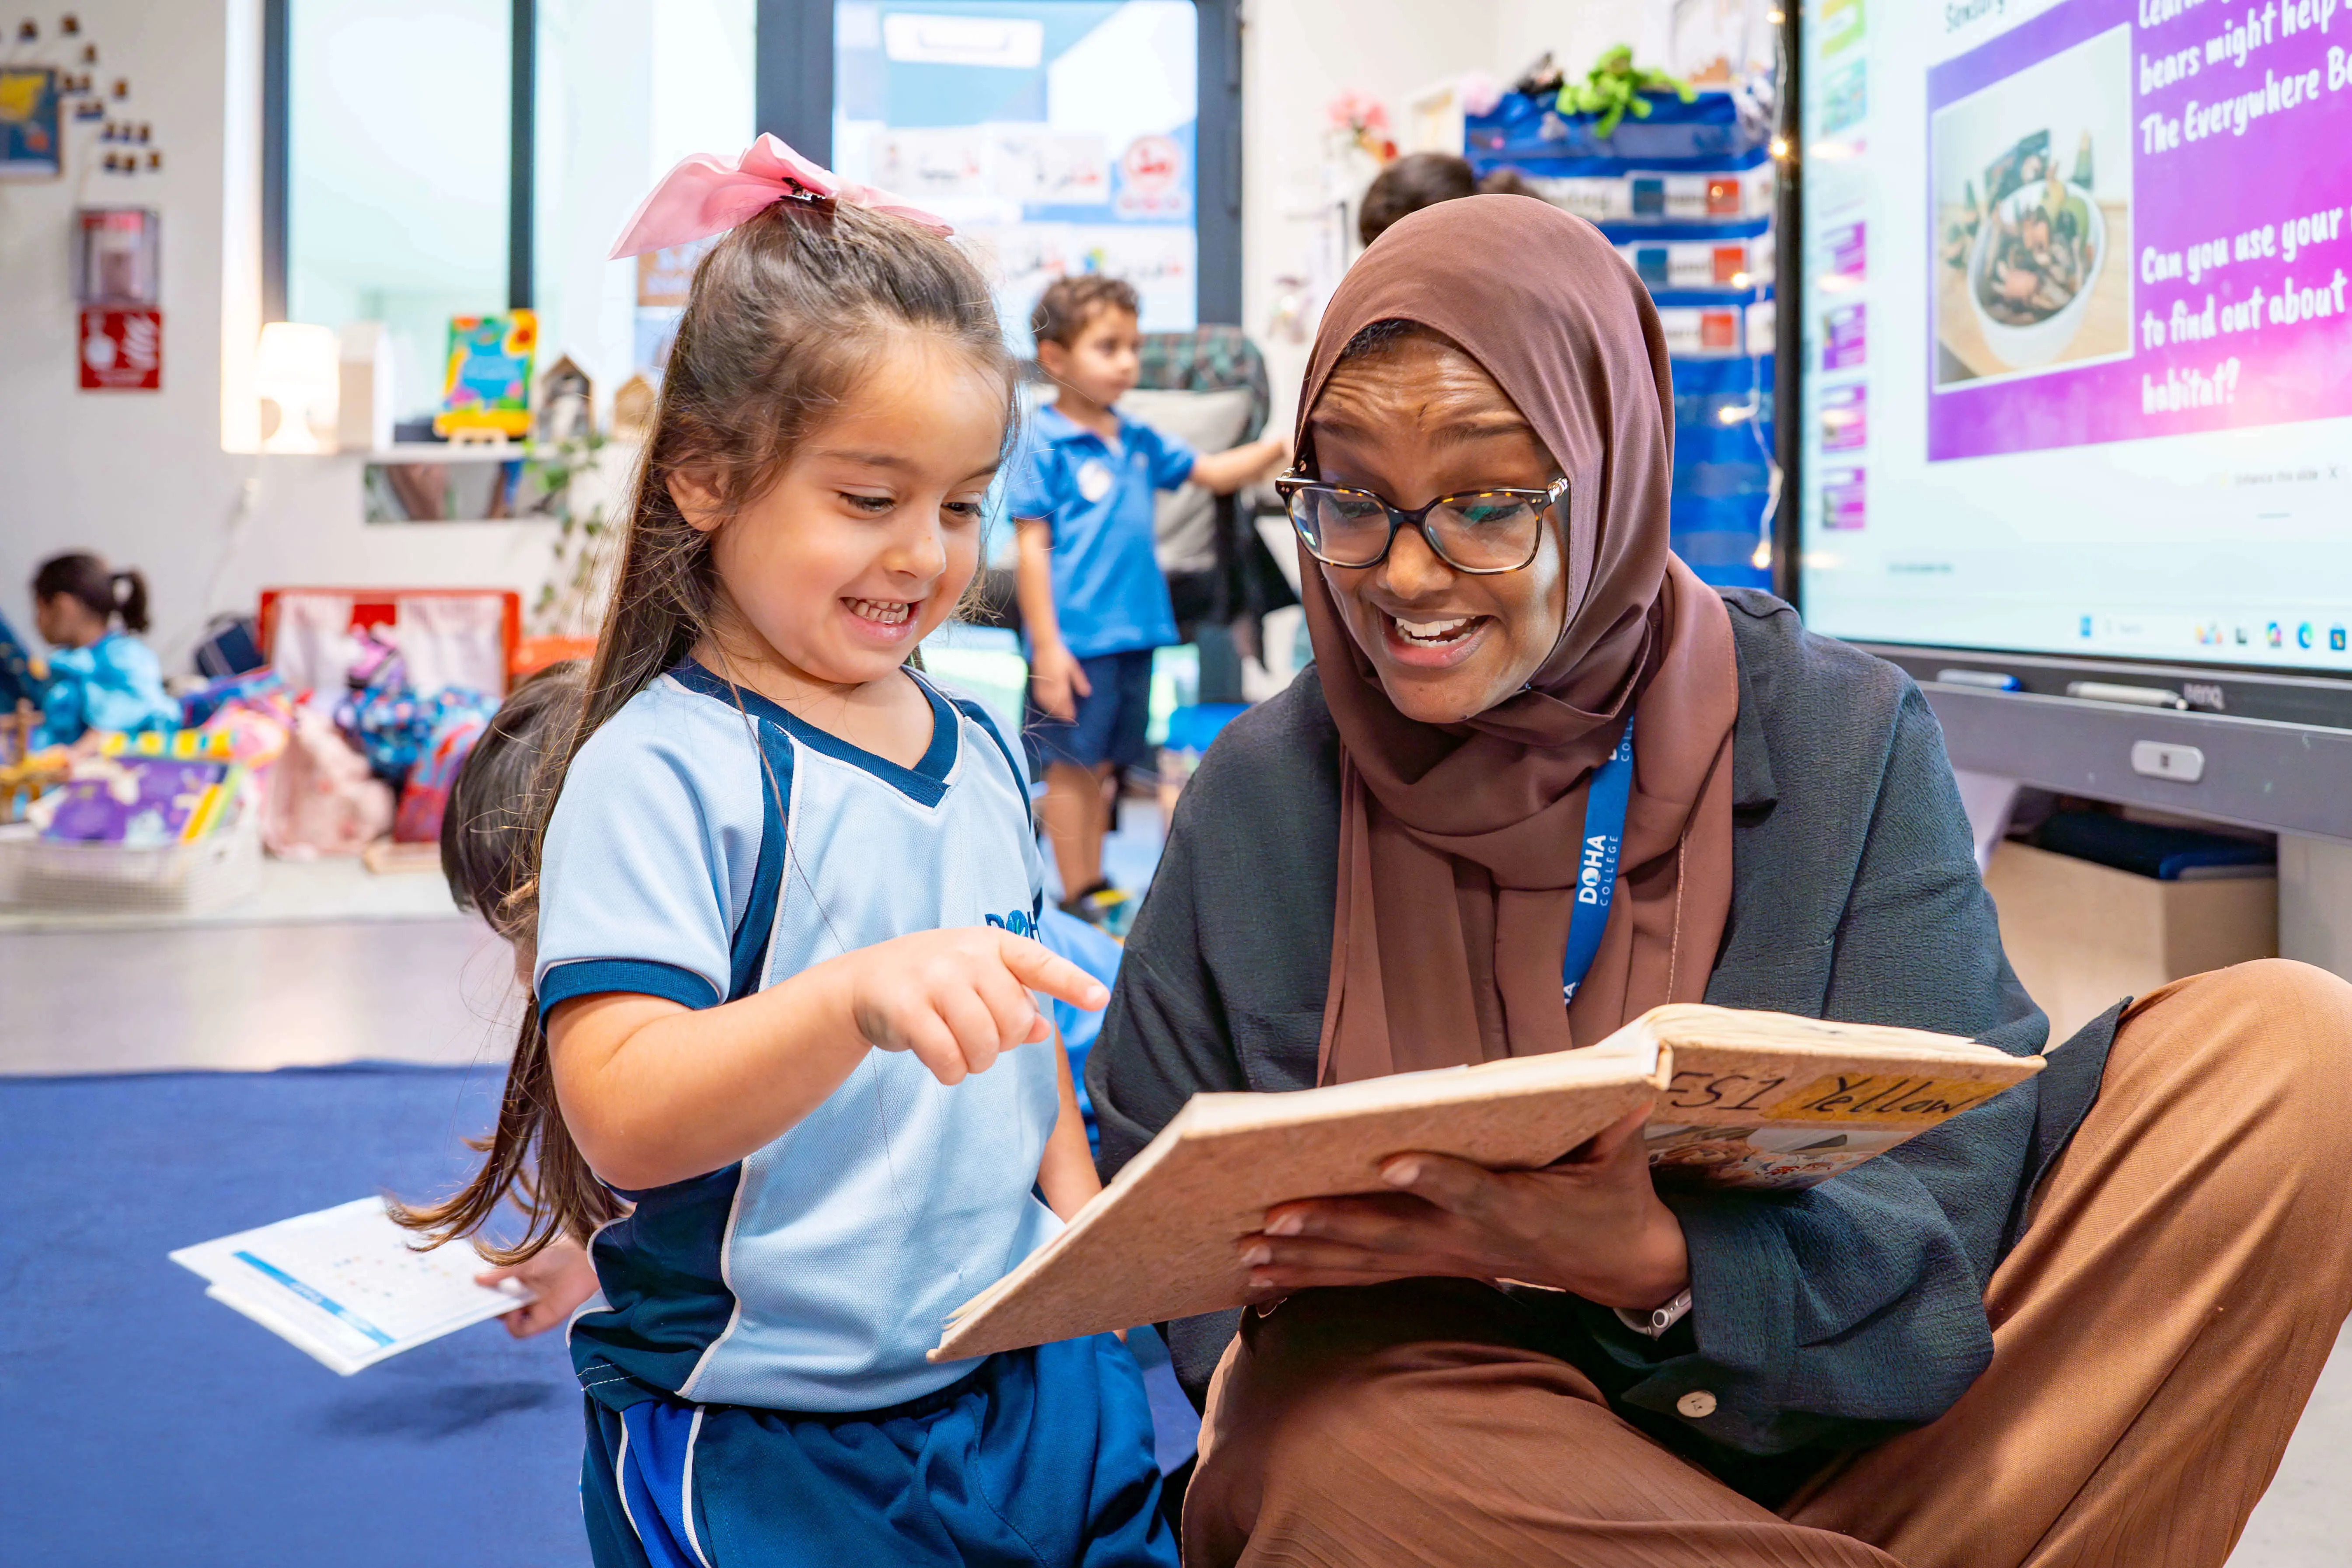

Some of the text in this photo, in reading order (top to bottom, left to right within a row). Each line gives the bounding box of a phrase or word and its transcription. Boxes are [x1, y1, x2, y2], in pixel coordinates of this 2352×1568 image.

[2139, 0, 2337, 96] bears might help
[2139, 112, 2180, 154] The
[2184, 68, 2320, 142] Everywhere
[2142, 246, 2183, 284] Can
[2187, 237, 2229, 285] you
[2235, 224, 2277, 262] use
[2282, 207, 2344, 263] your
[2140, 268, 2348, 350] to find out about
[2142, 356, 2241, 415] habitat?
[1578, 835, 1606, 904] DOHA
[1599, 836, 1618, 906] COLLEGE
[1798, 1076, 1987, 1114] Yellow
